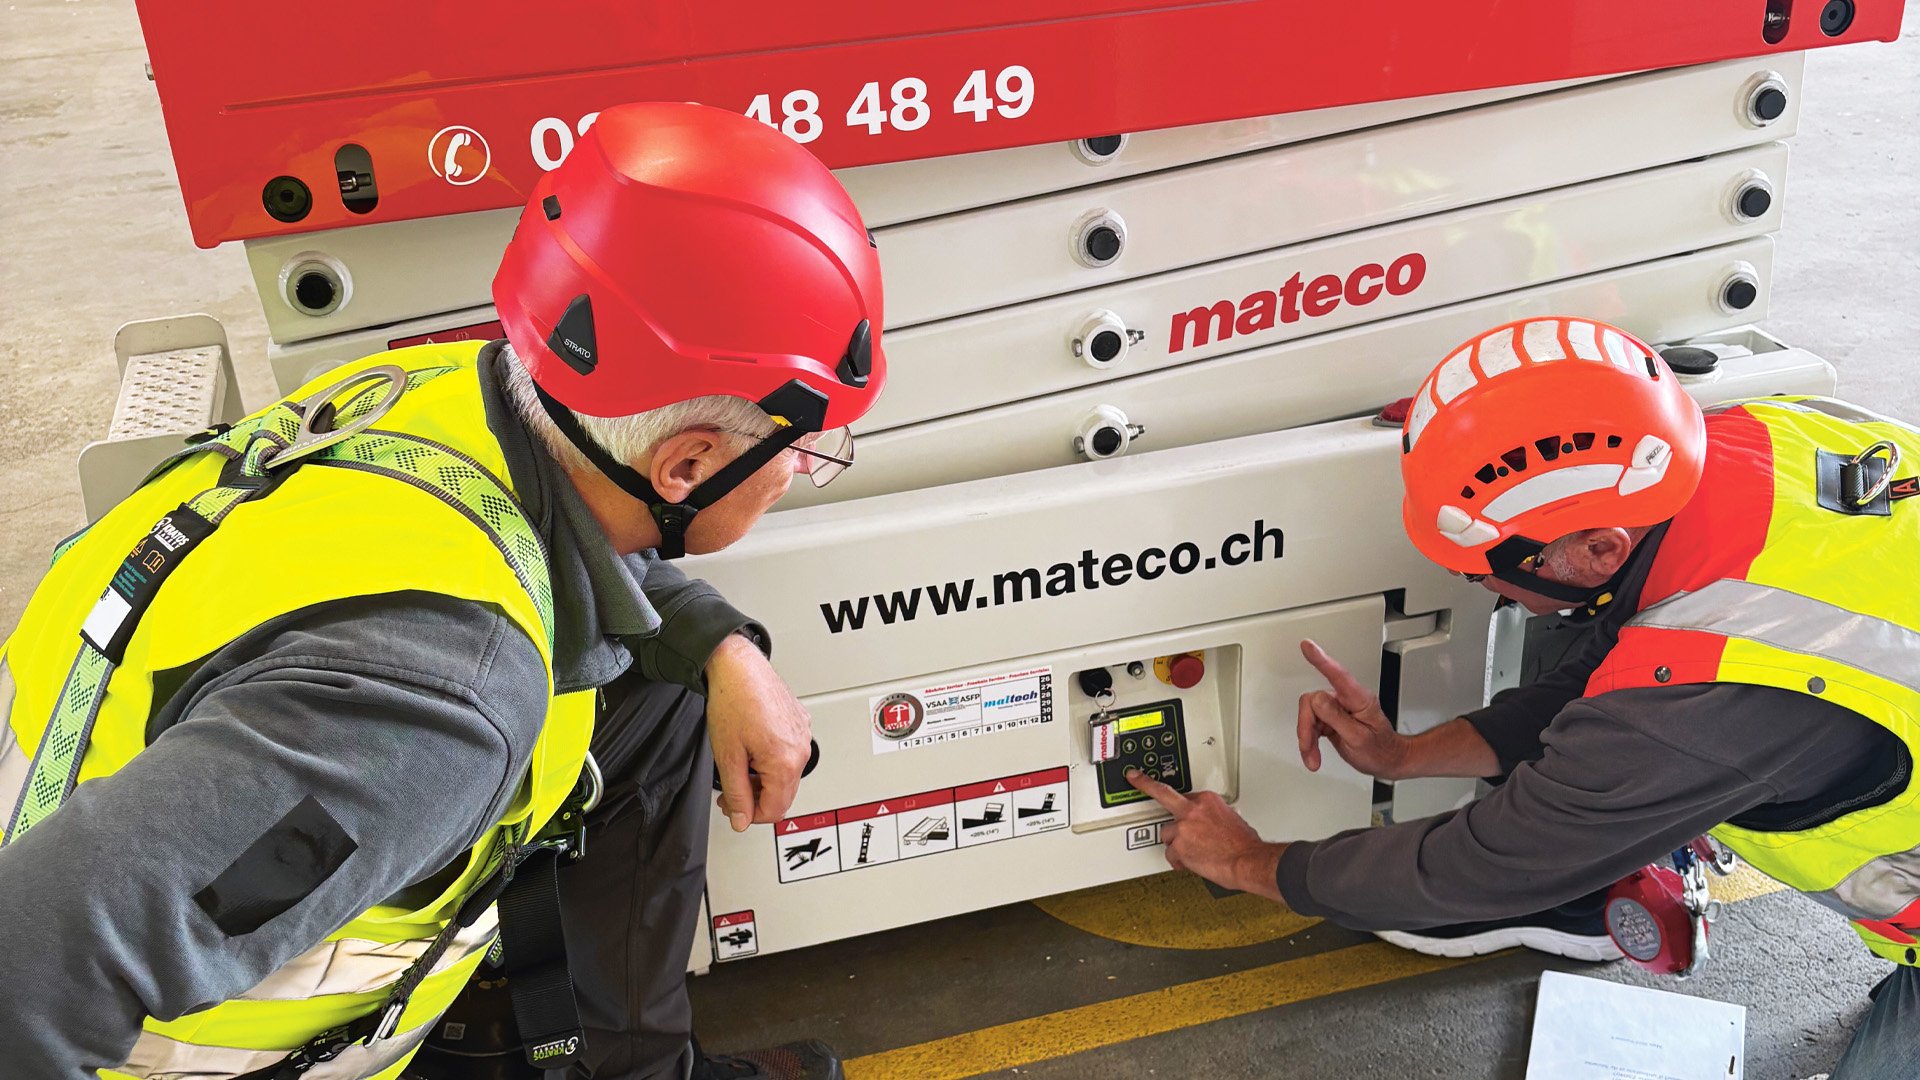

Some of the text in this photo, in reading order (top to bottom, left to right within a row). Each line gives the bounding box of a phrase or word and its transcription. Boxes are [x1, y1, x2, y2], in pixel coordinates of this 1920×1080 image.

[846, 76, 931, 135] 48
[952, 65, 1036, 122] 49
[1168, 252, 1427, 354] mateco
[564, 338, 591, 359] STRATO
[161, 523, 190, 546] KRATOS
[819, 519, 1285, 634] www.mateco.ch
[1041, 675, 1050, 683] 26
[926, 700, 948, 709] VSAA
